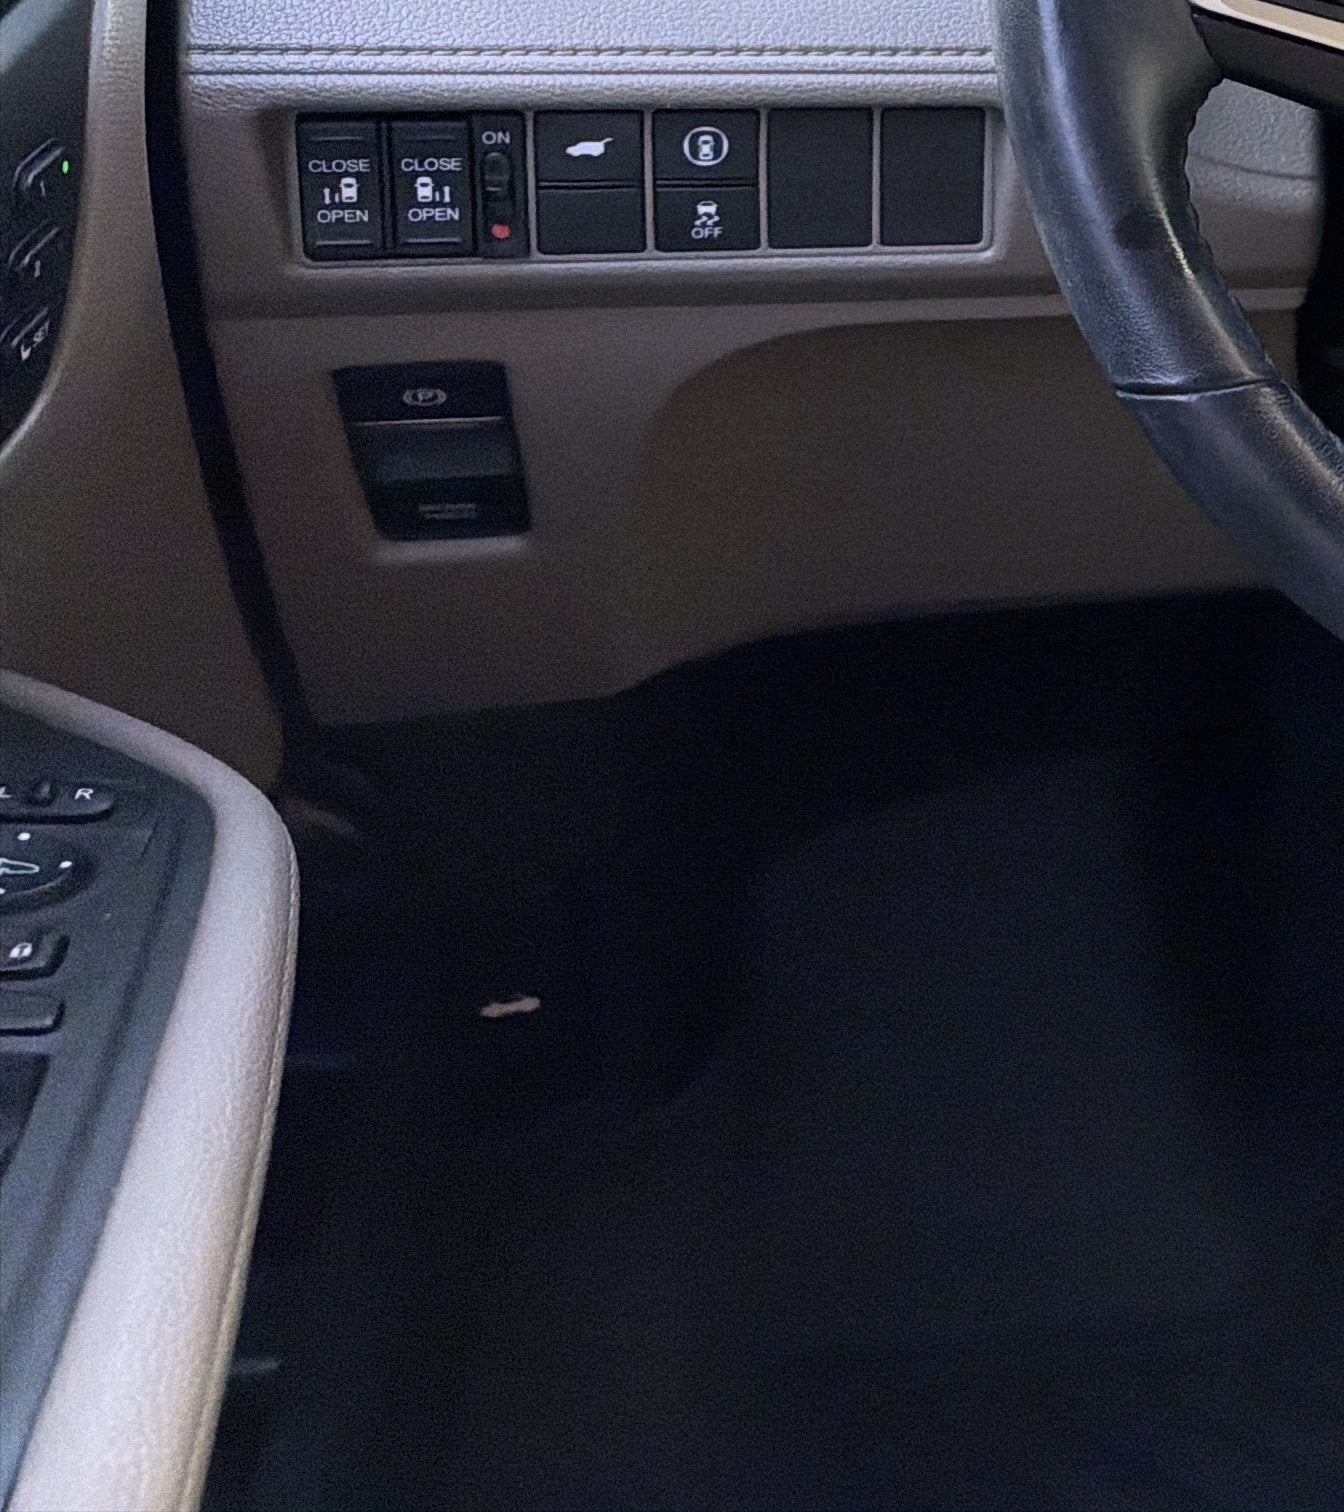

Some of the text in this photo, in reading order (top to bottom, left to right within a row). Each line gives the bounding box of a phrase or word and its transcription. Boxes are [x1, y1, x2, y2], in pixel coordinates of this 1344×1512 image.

[482, 131, 511, 145] ON
[308, 158, 371, 173] CLOSE
[401, 157, 463, 172] CLOSE
[317, 209, 369, 224] OPEN
[408, 207, 460, 223] OPEN
[691, 226, 723, 240] OFF
[74, 788, 94, 800] R
